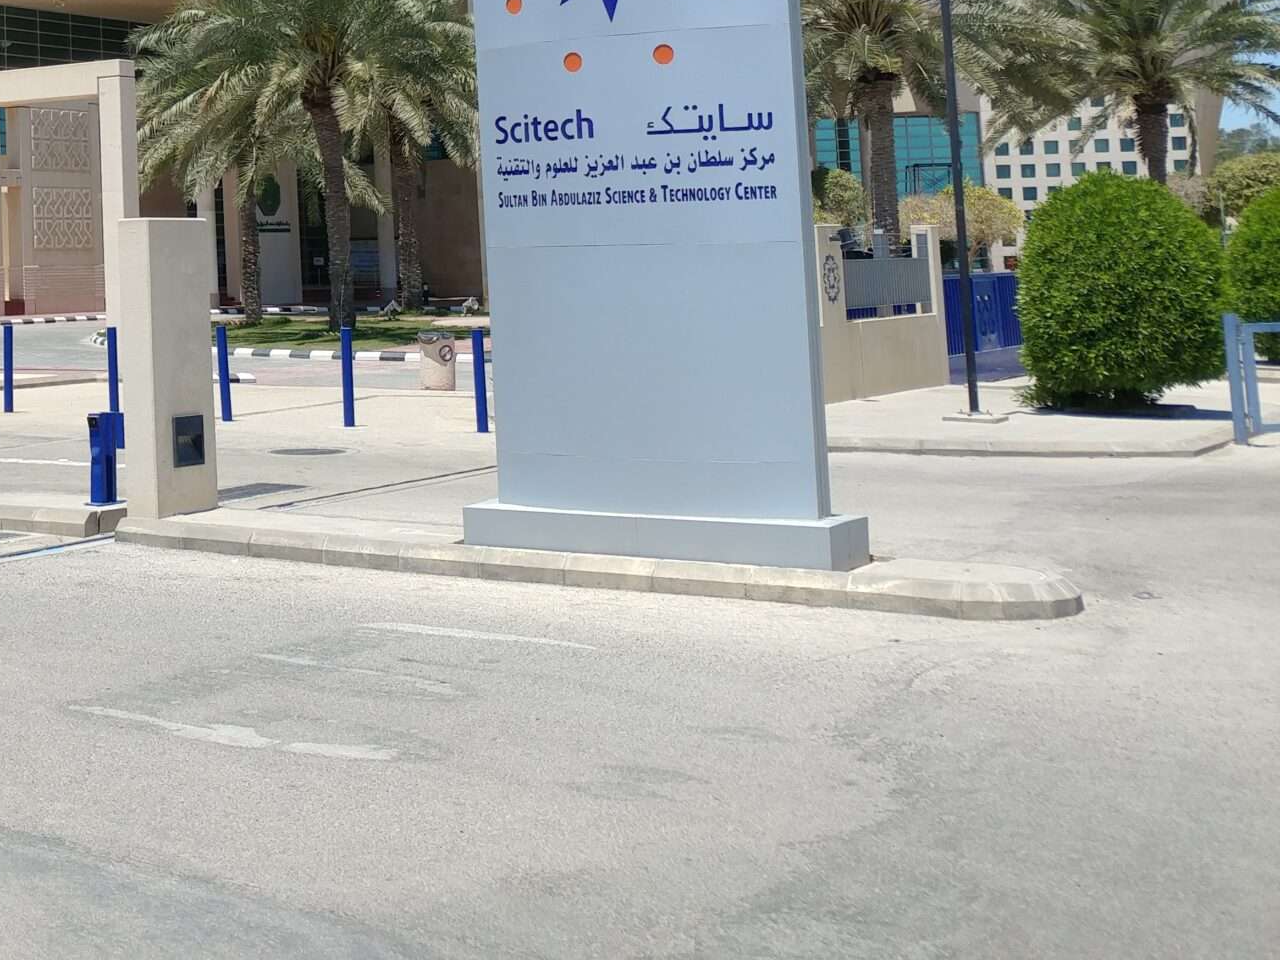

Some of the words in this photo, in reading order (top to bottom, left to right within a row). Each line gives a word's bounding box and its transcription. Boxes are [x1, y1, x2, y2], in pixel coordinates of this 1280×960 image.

[494, 108, 595, 145] Scitech
[646, 103, 773, 141] سايتك
[496, 156, 540, 182] والتقنية
[545, 157, 578, 179] للعلوم
[584, 154, 624, 179] العزيز
[630, 155, 657, 176] عبد
[664, 152, 681, 175] بن
[687, 149, 734, 173] سلطان
[738, 146, 776, 171] مركز
[649, 187, 657, 203] &
